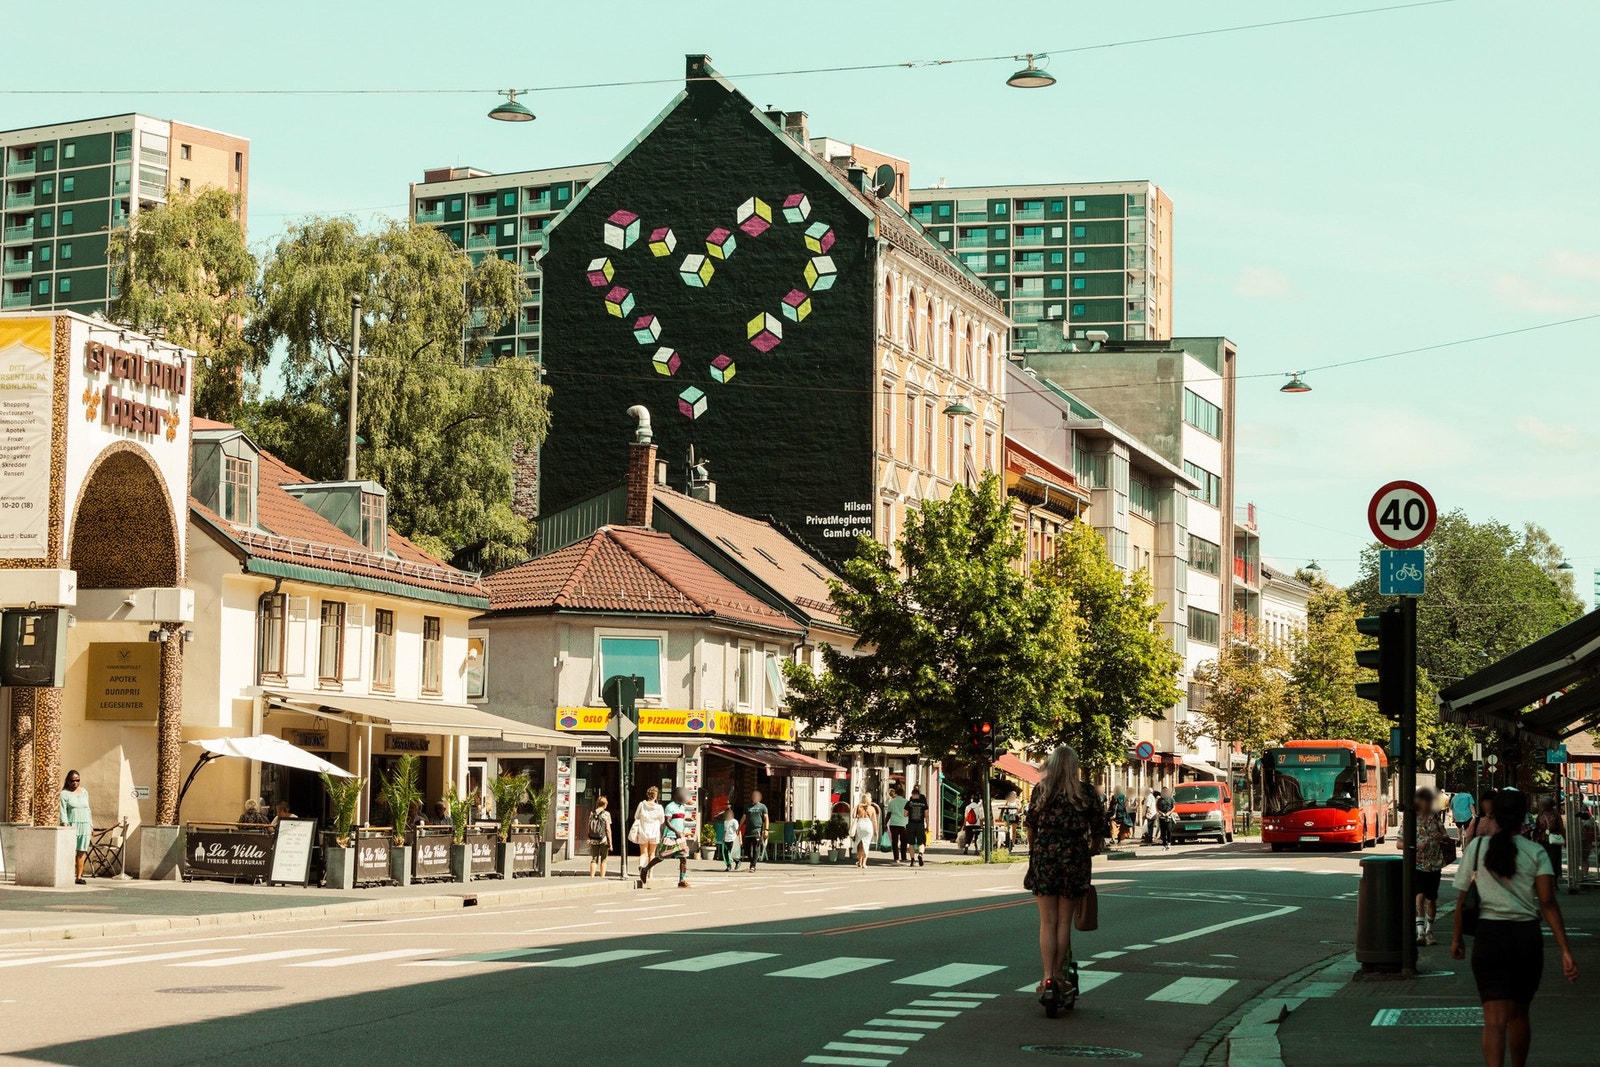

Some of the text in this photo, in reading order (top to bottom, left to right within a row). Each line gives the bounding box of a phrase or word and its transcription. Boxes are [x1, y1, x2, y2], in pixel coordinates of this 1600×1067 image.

[0, 373, 35, 381] RSENTER
[844, 502, 872, 511] Hilsen
[1380, 498, 1425, 531] 40
[806, 515, 872, 526] PrivatMegleren
[823, 528, 872, 538] Gamle Oslo
[583, 715, 603, 723] OSLO
[647, 716, 687, 725] PIZZAHUS
[1278, 754, 1286, 764] 37
[1298, 754, 1320, 764] Nydalen
[206, 842, 229, 858] La
[230, 843, 267, 859] Villa
